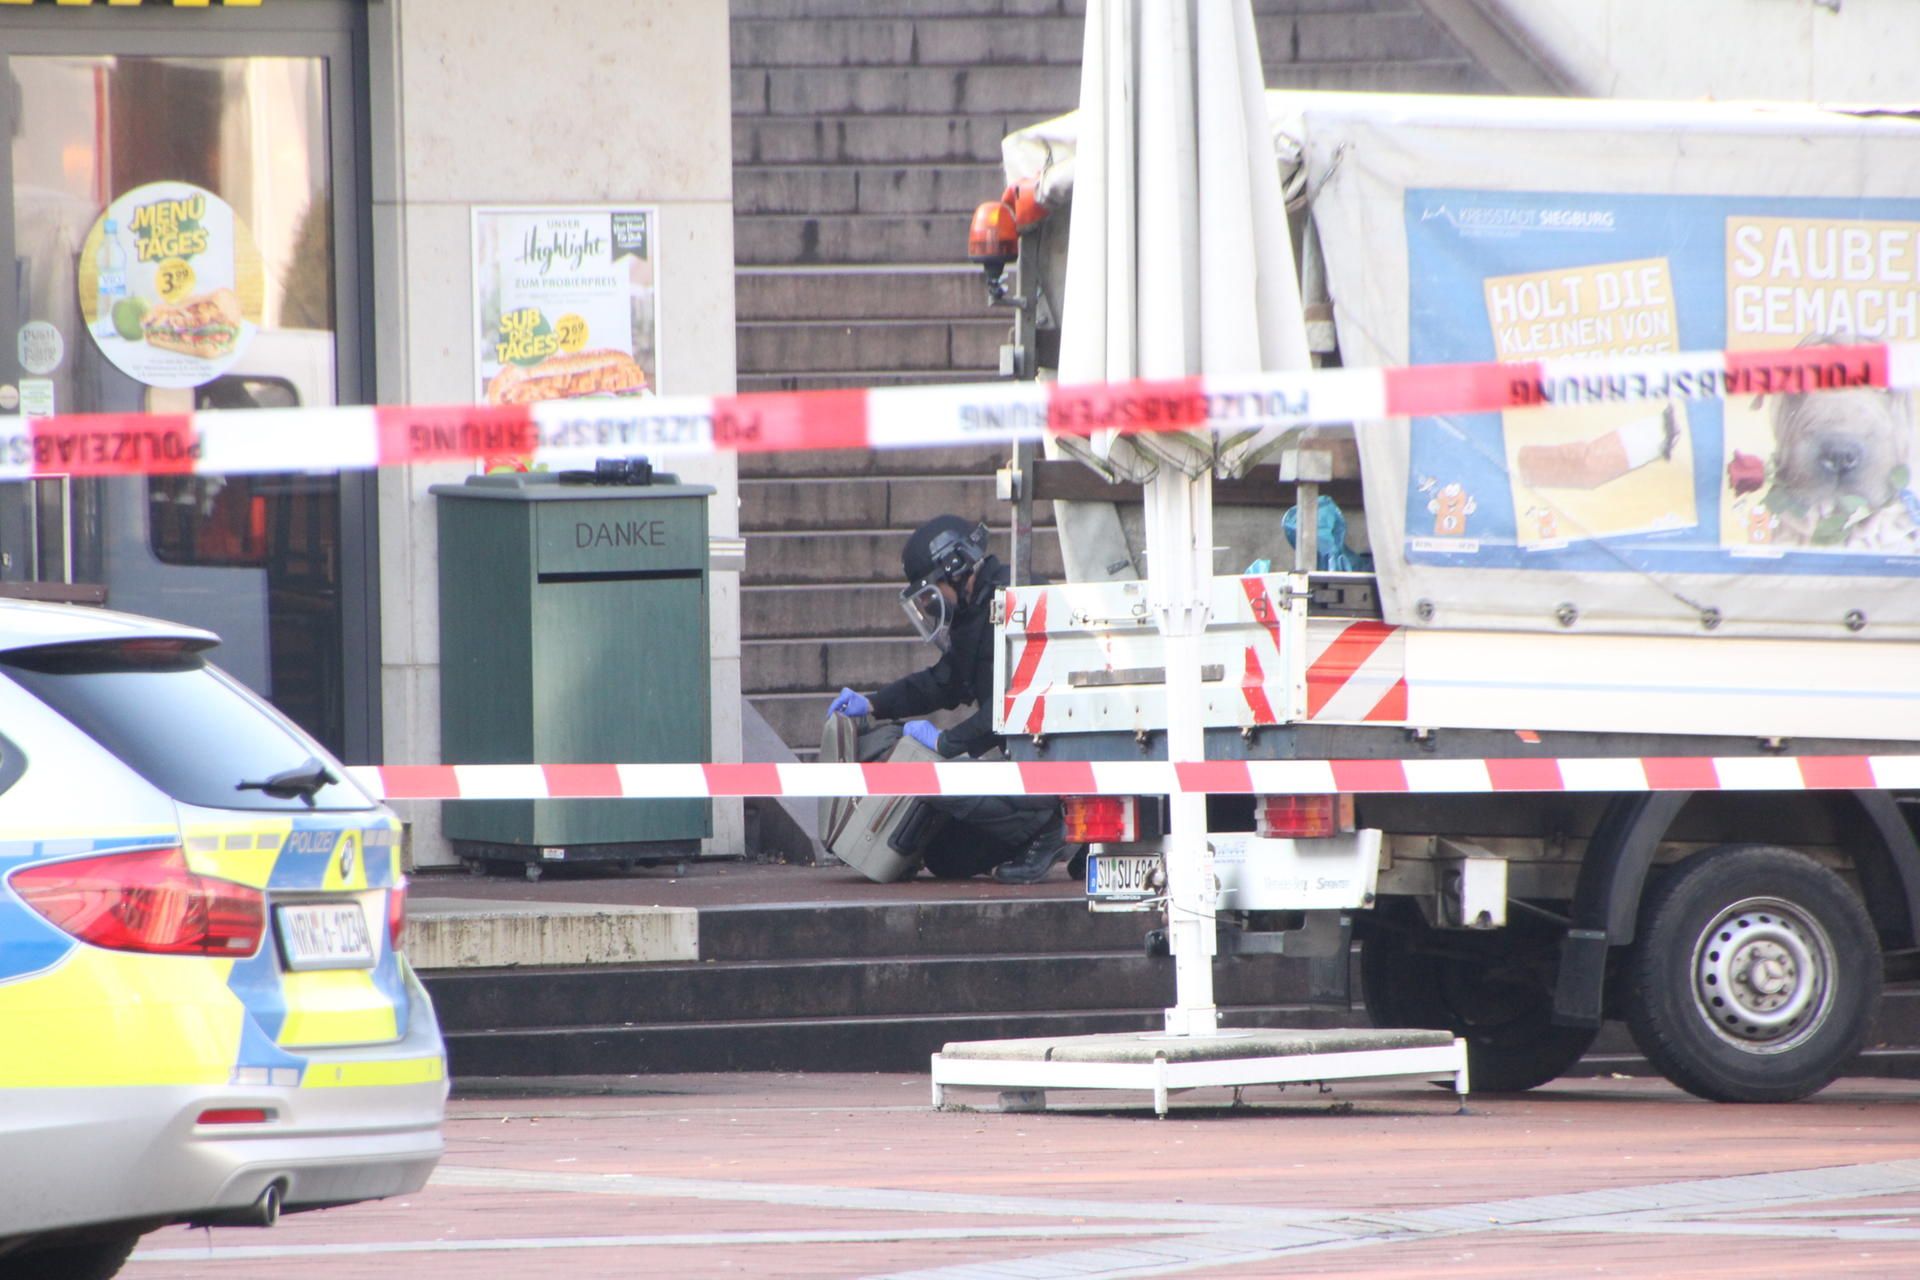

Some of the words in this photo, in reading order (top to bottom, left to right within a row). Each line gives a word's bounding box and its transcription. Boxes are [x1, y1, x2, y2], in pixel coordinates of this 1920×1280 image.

[131, 194, 206, 229] MENÜ
[546, 218, 580, 229] UNSER
[1459, 207, 1536, 225] KREISSTADT
[1540, 209, 1615, 227] SIEGBURG
[138, 229, 208, 261] TAGES
[151, 222, 179, 237] DES
[515, 224, 608, 275] Highlight
[1733, 225, 1920, 282] SAUBE
[515, 277, 539, 289] ZUM
[542, 276, 617, 289] PROBIERPREIS
[1490, 274, 1584, 324] HOLT
[1595, 265, 1667, 313] DIE
[499, 307, 541, 334] SUB
[1734, 285, 1920, 338] GEMACH
[496, 331, 558, 364] TAGES
[510, 326, 534, 341] DES
[1500, 316, 1614, 354] KLEINEN
[1620, 309, 1670, 340] VON
[1510, 360, 1871, 406] POLIZEIABSPERRUNG
[958, 388, 1309, 432] POLIZEIABSPERRUNG
[409, 409, 763, 454] POLIZEIABSPERRUNG
[576, 521, 666, 548] DANKE
[289, 831, 336, 854] POLIZEI
[1098, 859, 1110, 889] SU
[1118, 859, 1131, 889] SU
